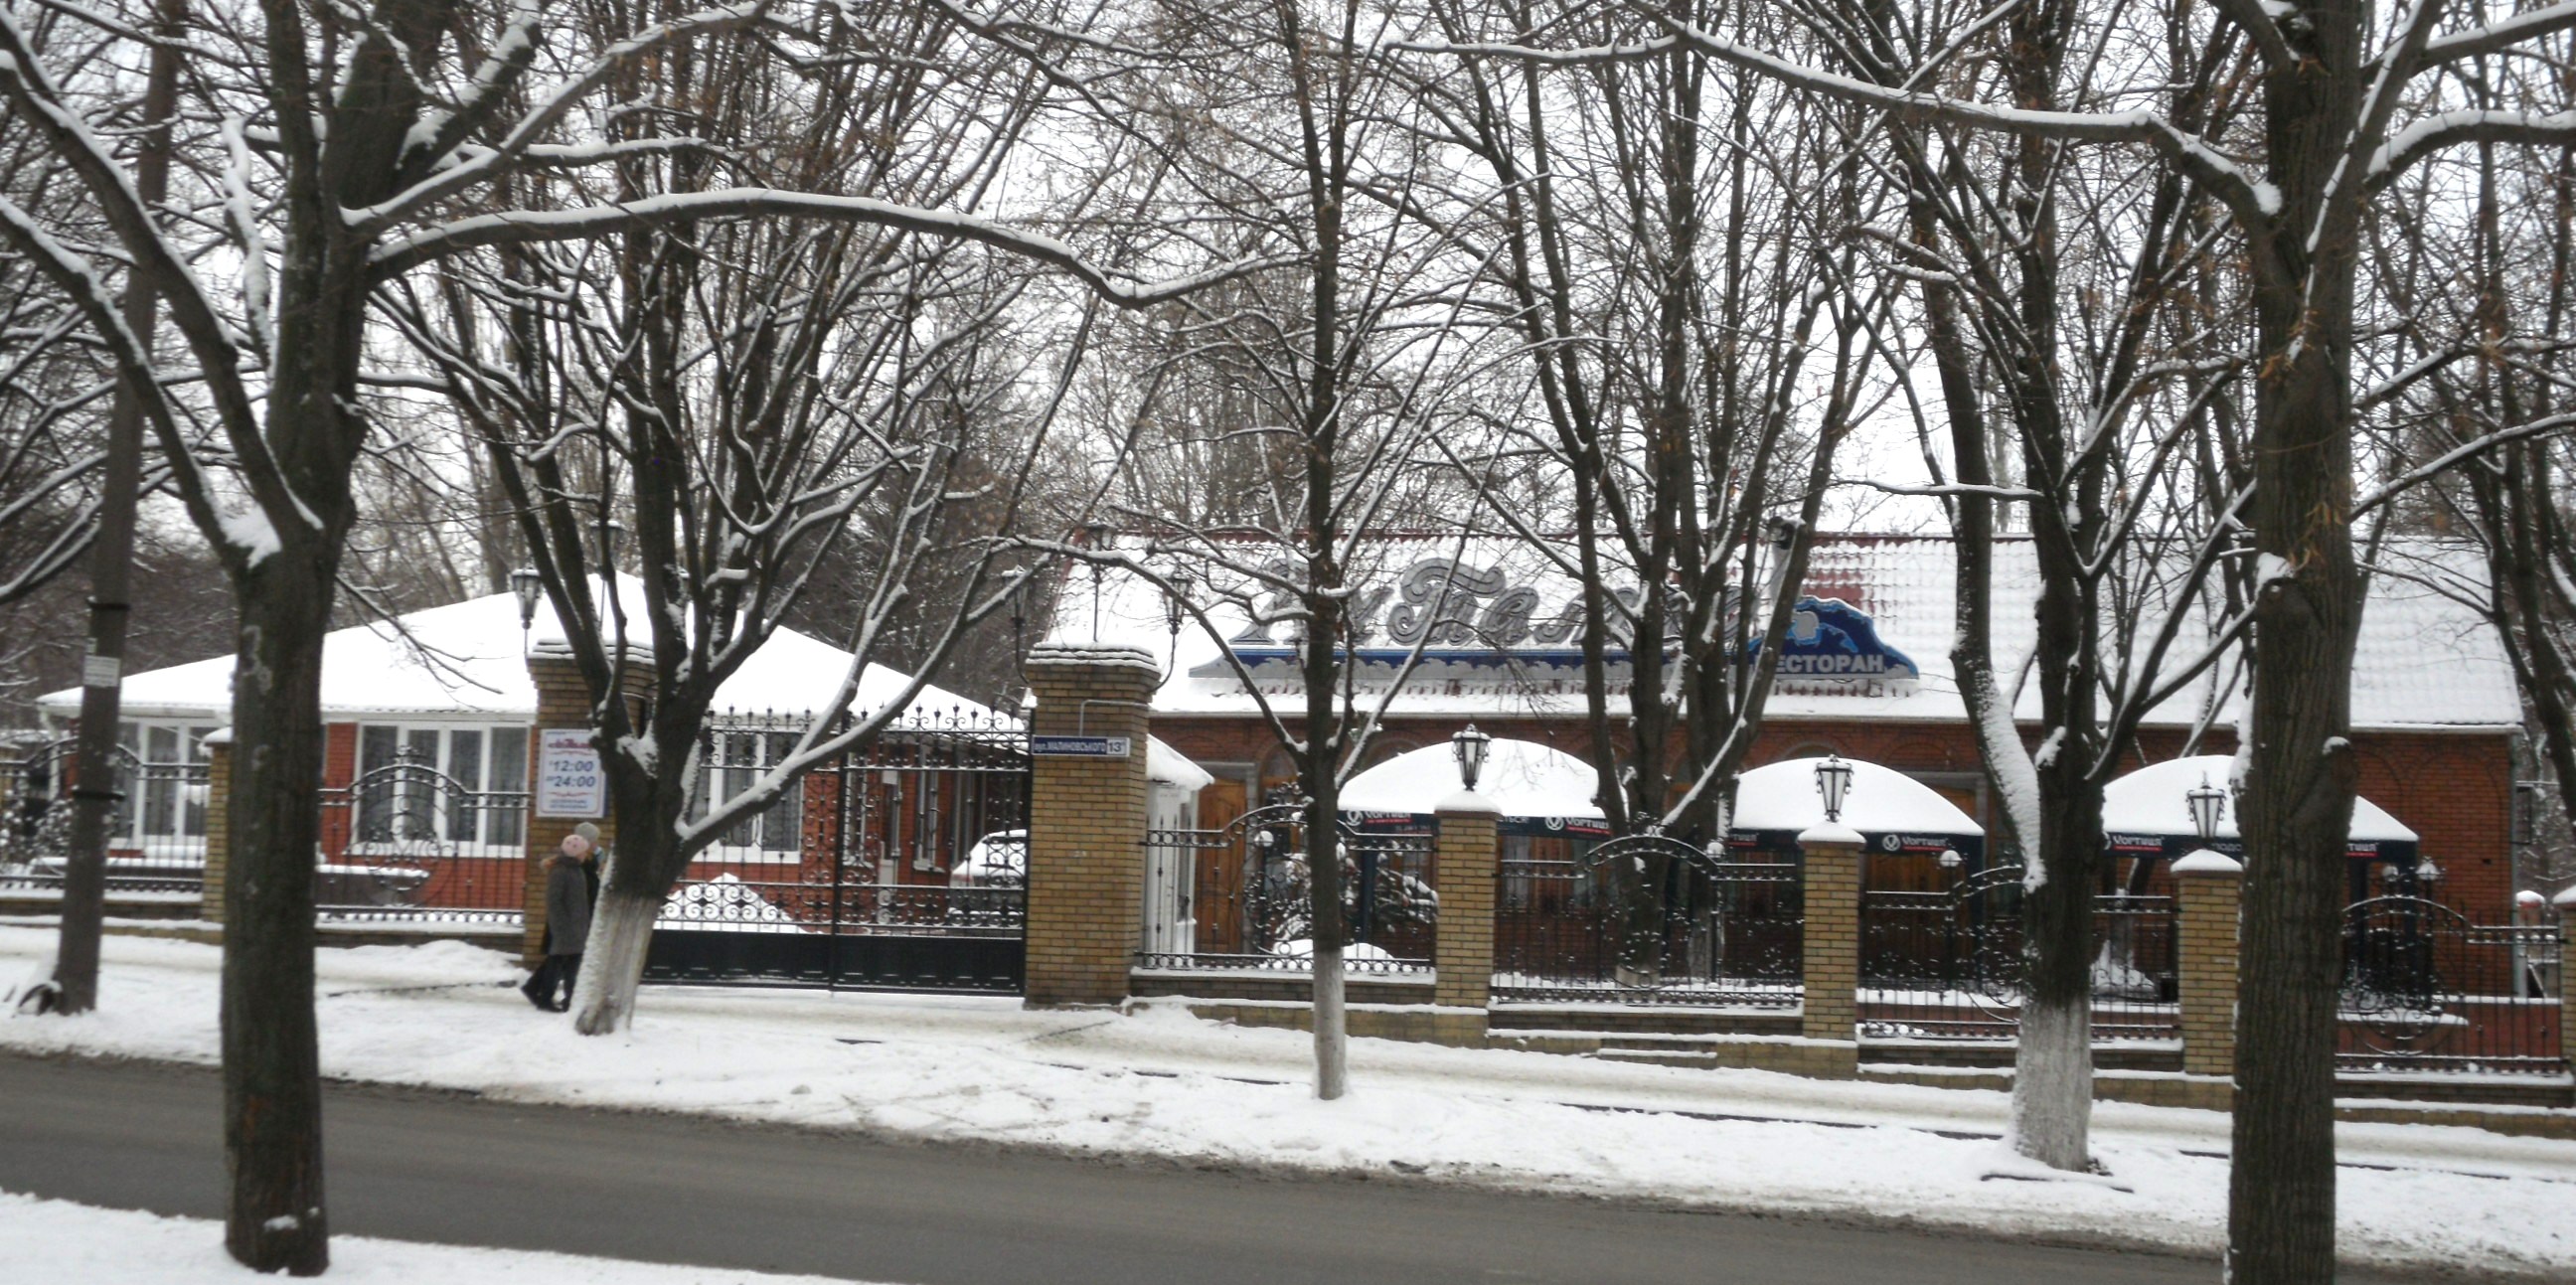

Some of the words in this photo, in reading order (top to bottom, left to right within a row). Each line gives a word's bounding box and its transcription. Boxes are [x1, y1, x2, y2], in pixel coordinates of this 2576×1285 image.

[1755, 653, 1884, 674] ЕСТОРАН
[554, 760, 594, 772] 12:00
[554, 775, 595, 787] 24:00
